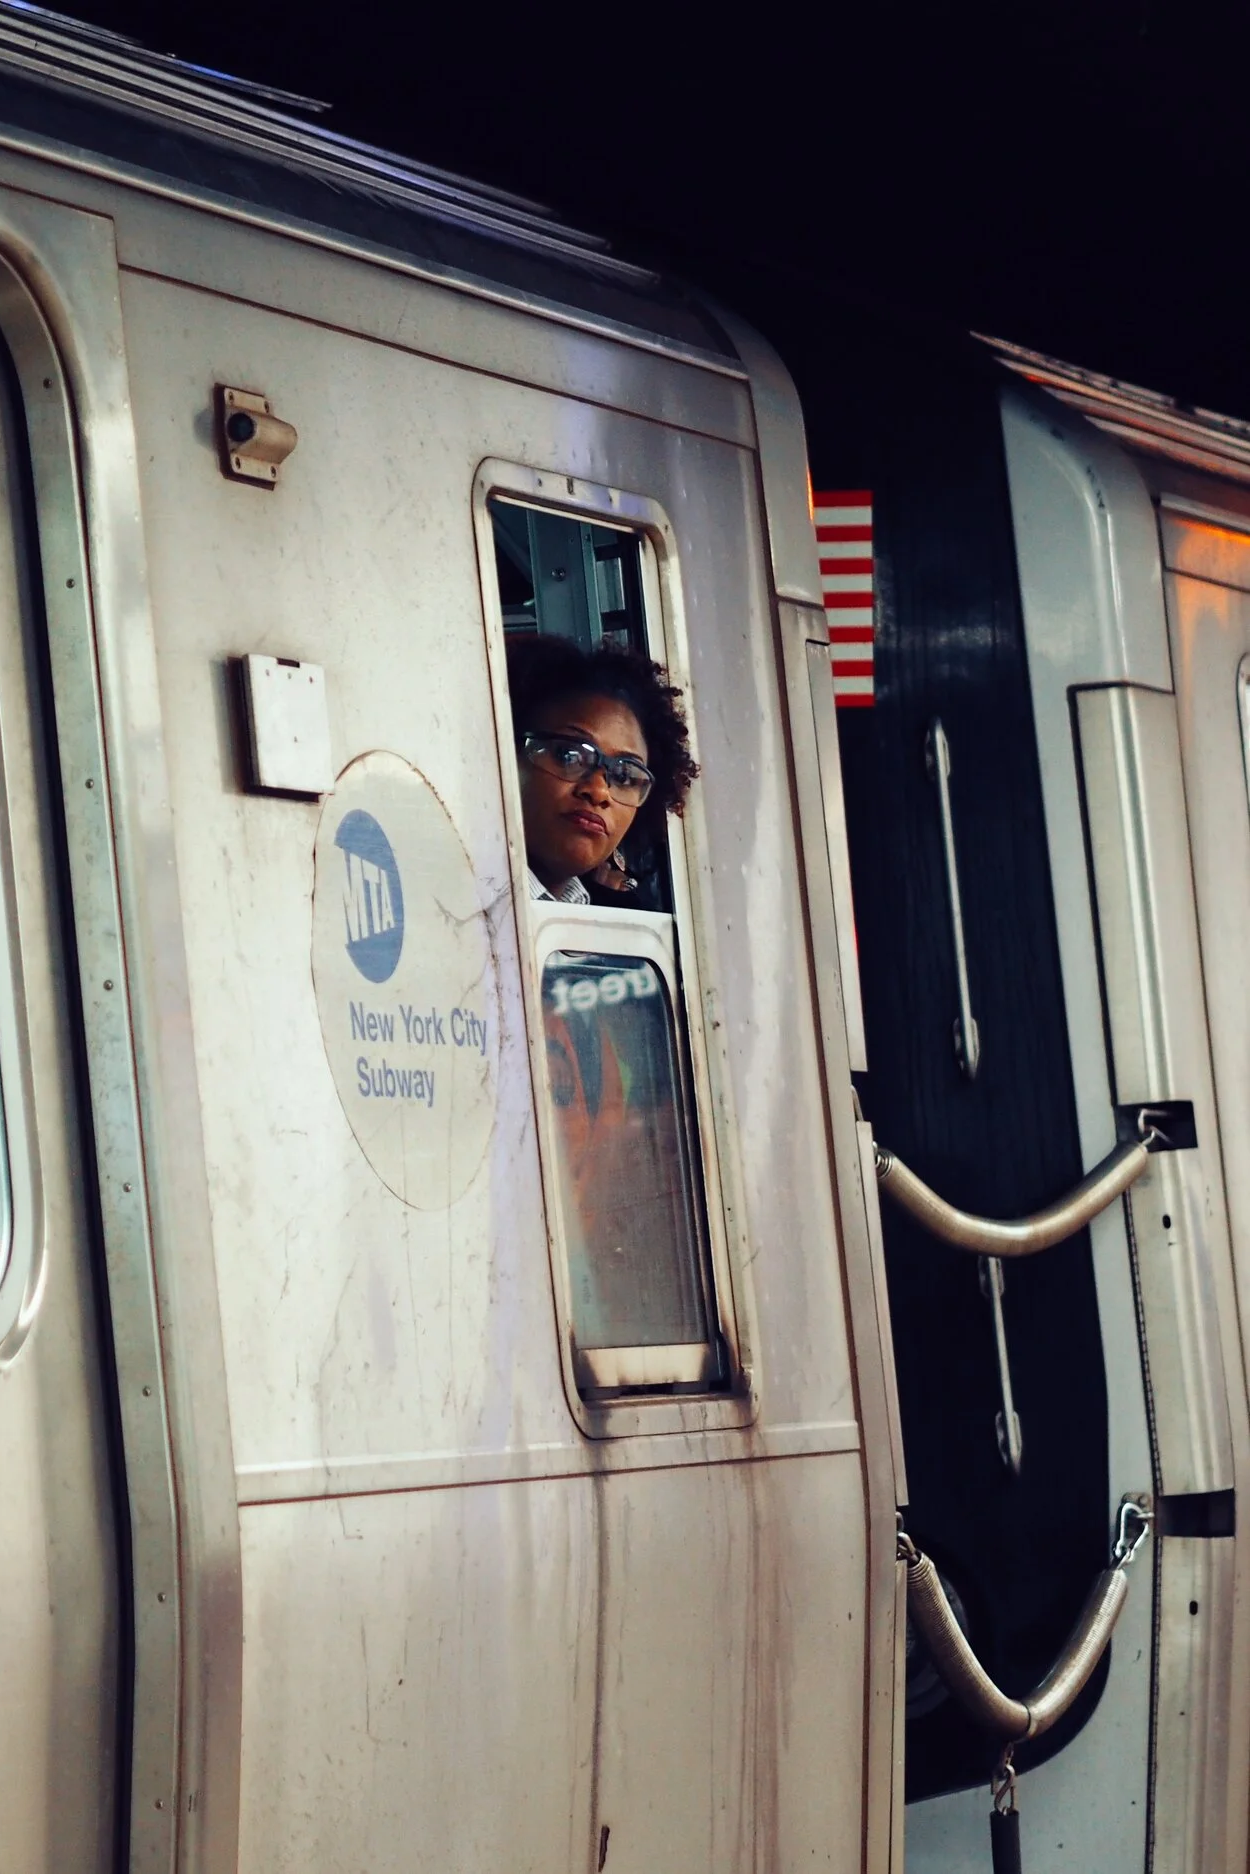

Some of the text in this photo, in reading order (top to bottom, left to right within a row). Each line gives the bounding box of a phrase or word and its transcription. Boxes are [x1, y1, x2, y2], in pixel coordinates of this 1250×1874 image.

[342, 850, 396, 943] MTA
[349, 1000, 487, 1057] New York City
[356, 1056, 435, 1108] Subway
